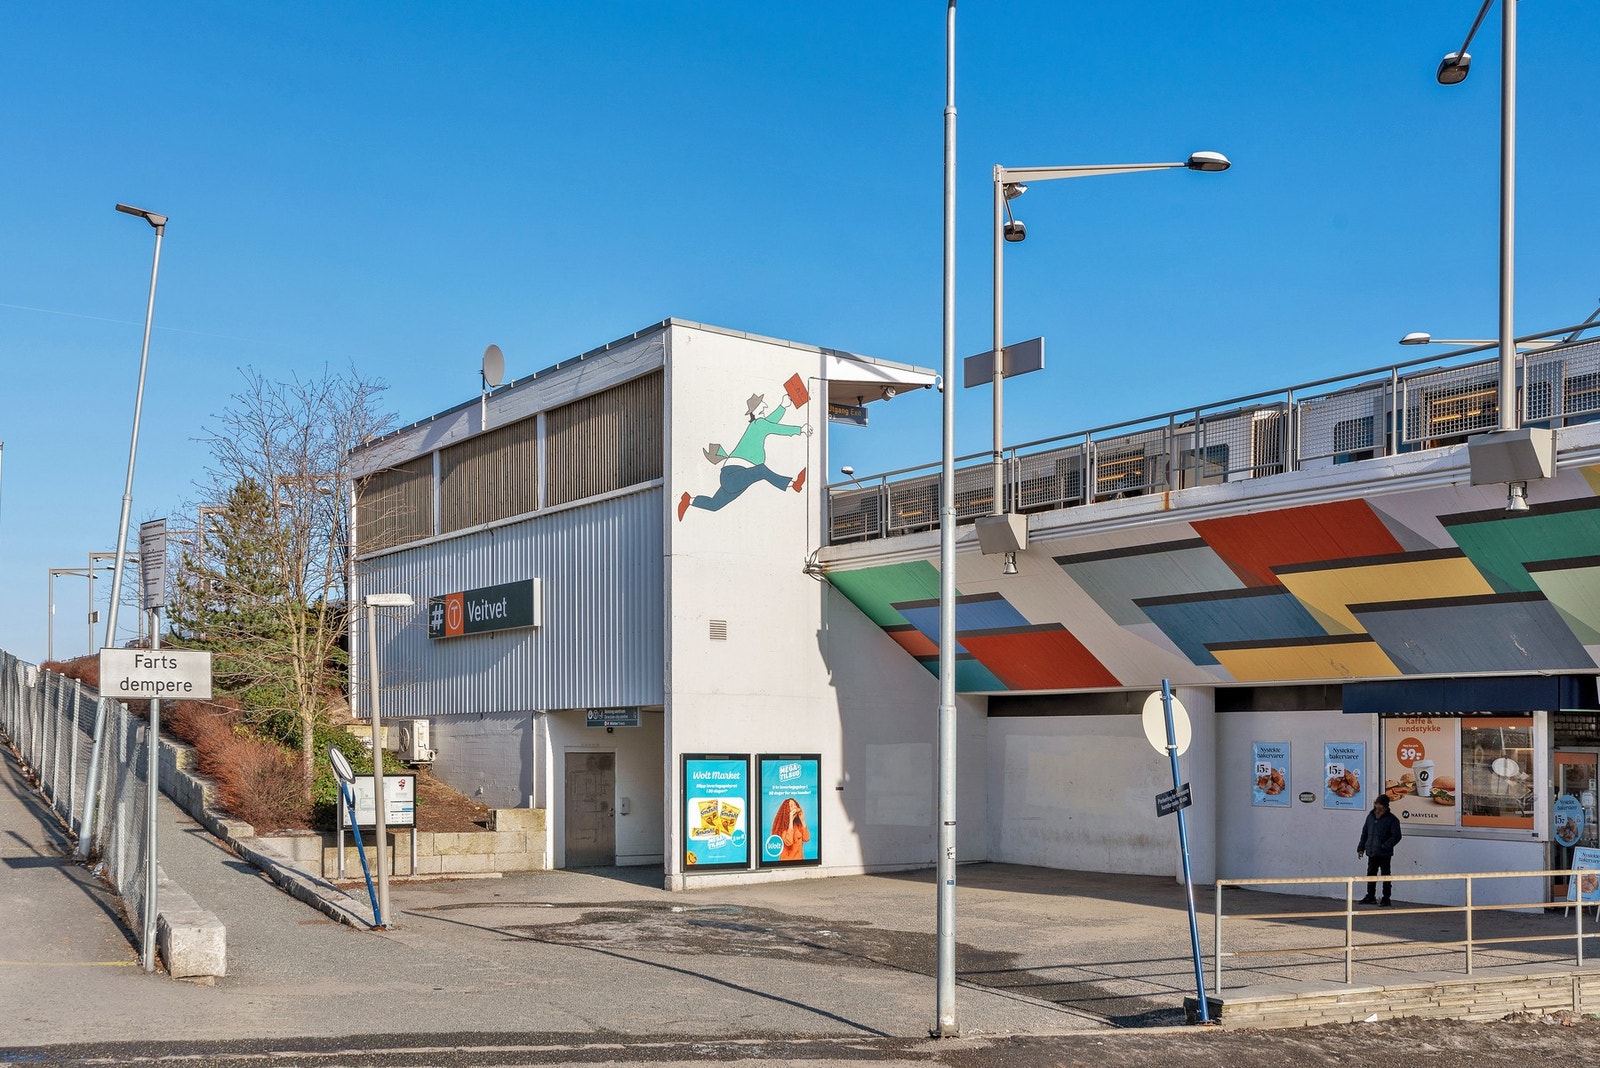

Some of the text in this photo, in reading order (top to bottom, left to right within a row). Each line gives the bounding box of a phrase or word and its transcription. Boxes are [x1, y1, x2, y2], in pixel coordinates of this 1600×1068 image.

[467, 597, 507, 622] Veitvet
[135, 654, 177, 669] Farts
[120, 677, 192, 695] dempere
[1398, 725, 1441, 733] rundstykke
[692, 771, 741, 780] Wolt Market
[780, 770, 801, 781] TILBUD
